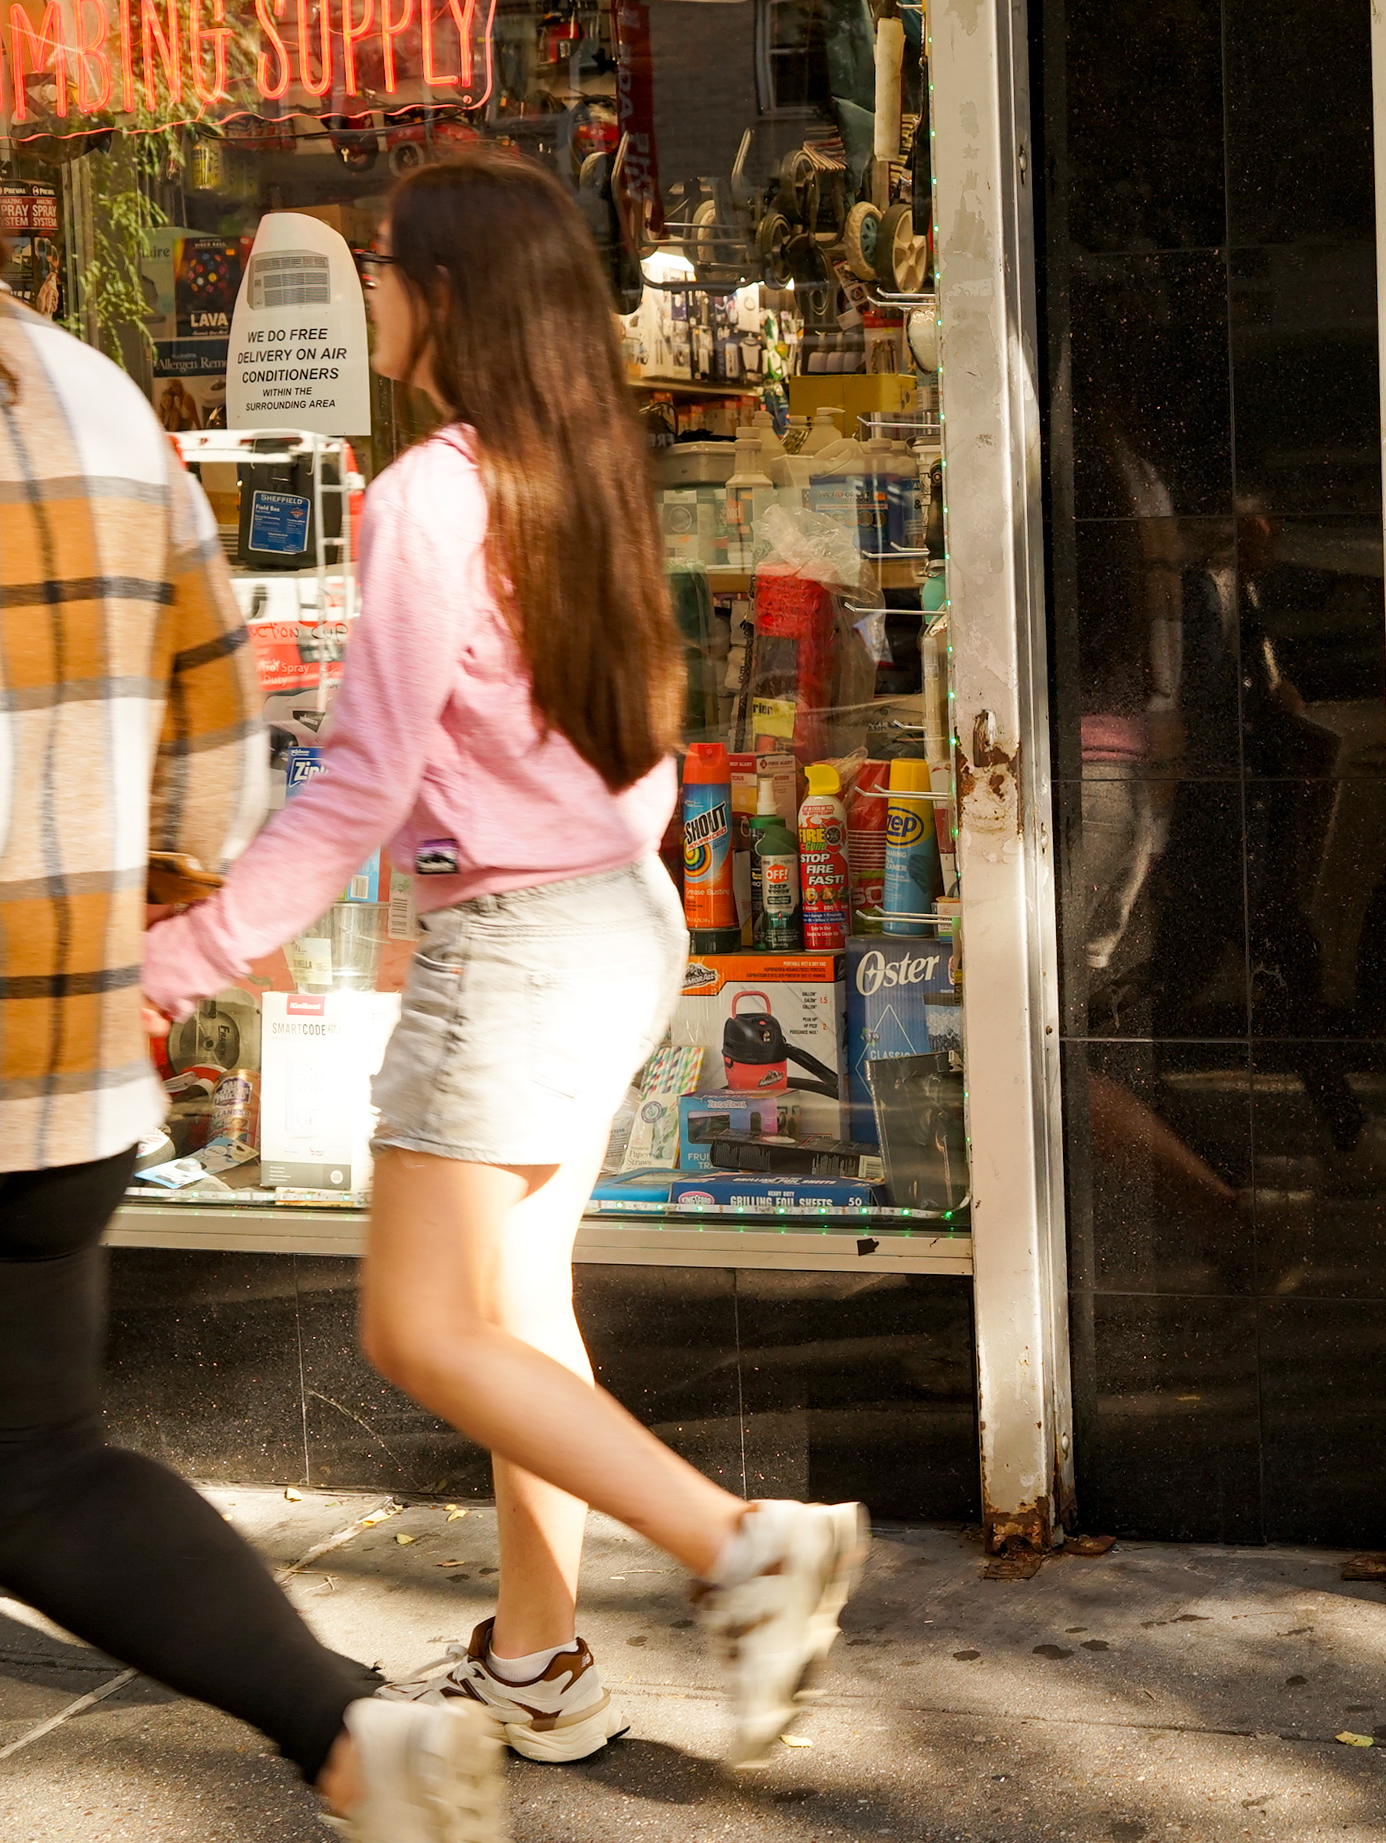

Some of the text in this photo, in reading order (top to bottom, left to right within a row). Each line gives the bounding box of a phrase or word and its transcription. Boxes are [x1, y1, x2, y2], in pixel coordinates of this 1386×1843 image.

[256, 0, 474, 99] SUPPLY
[32, 204, 57, 217] SPRAY
[33, 217, 57, 227] SYSTEM
[190, 312, 229, 327] LAVA
[247, 328, 328, 343] WE DO FREE
[237, 347, 347, 364] DELIVERY ON AIR
[156, 358, 198, 373] Allergen
[242, 367, 339, 383] CONDITIONERS
[262, 387, 312, 397] WITHIN THE
[245, 399, 336, 411] SURROUNDING AREA
[260, 494, 303, 505] SHEFFIELD
[311, 623, 349, 642] CUP
[281, 662, 310, 675] Spray
[263, 674, 288, 687] Duty
[686, 802, 726, 845] SHOUT
[688, 827, 727, 850] ADVANCED
[799, 828, 826, 843] FIRE
[800, 853, 831, 863] STOP
[766, 868, 788, 880] OFF!
[806, 864, 834, 874] FIRE
[808, 874, 845, 886] FAST!
[856, 950, 941, 996] Oster
[289, 1002, 321, 1010] Kwikset
[629, 1150, 652, 1160] Paper
[626, 1158, 652, 1166] Straws
[730, 1196, 862, 1206] GRILLING FOIL SHEETS 50
